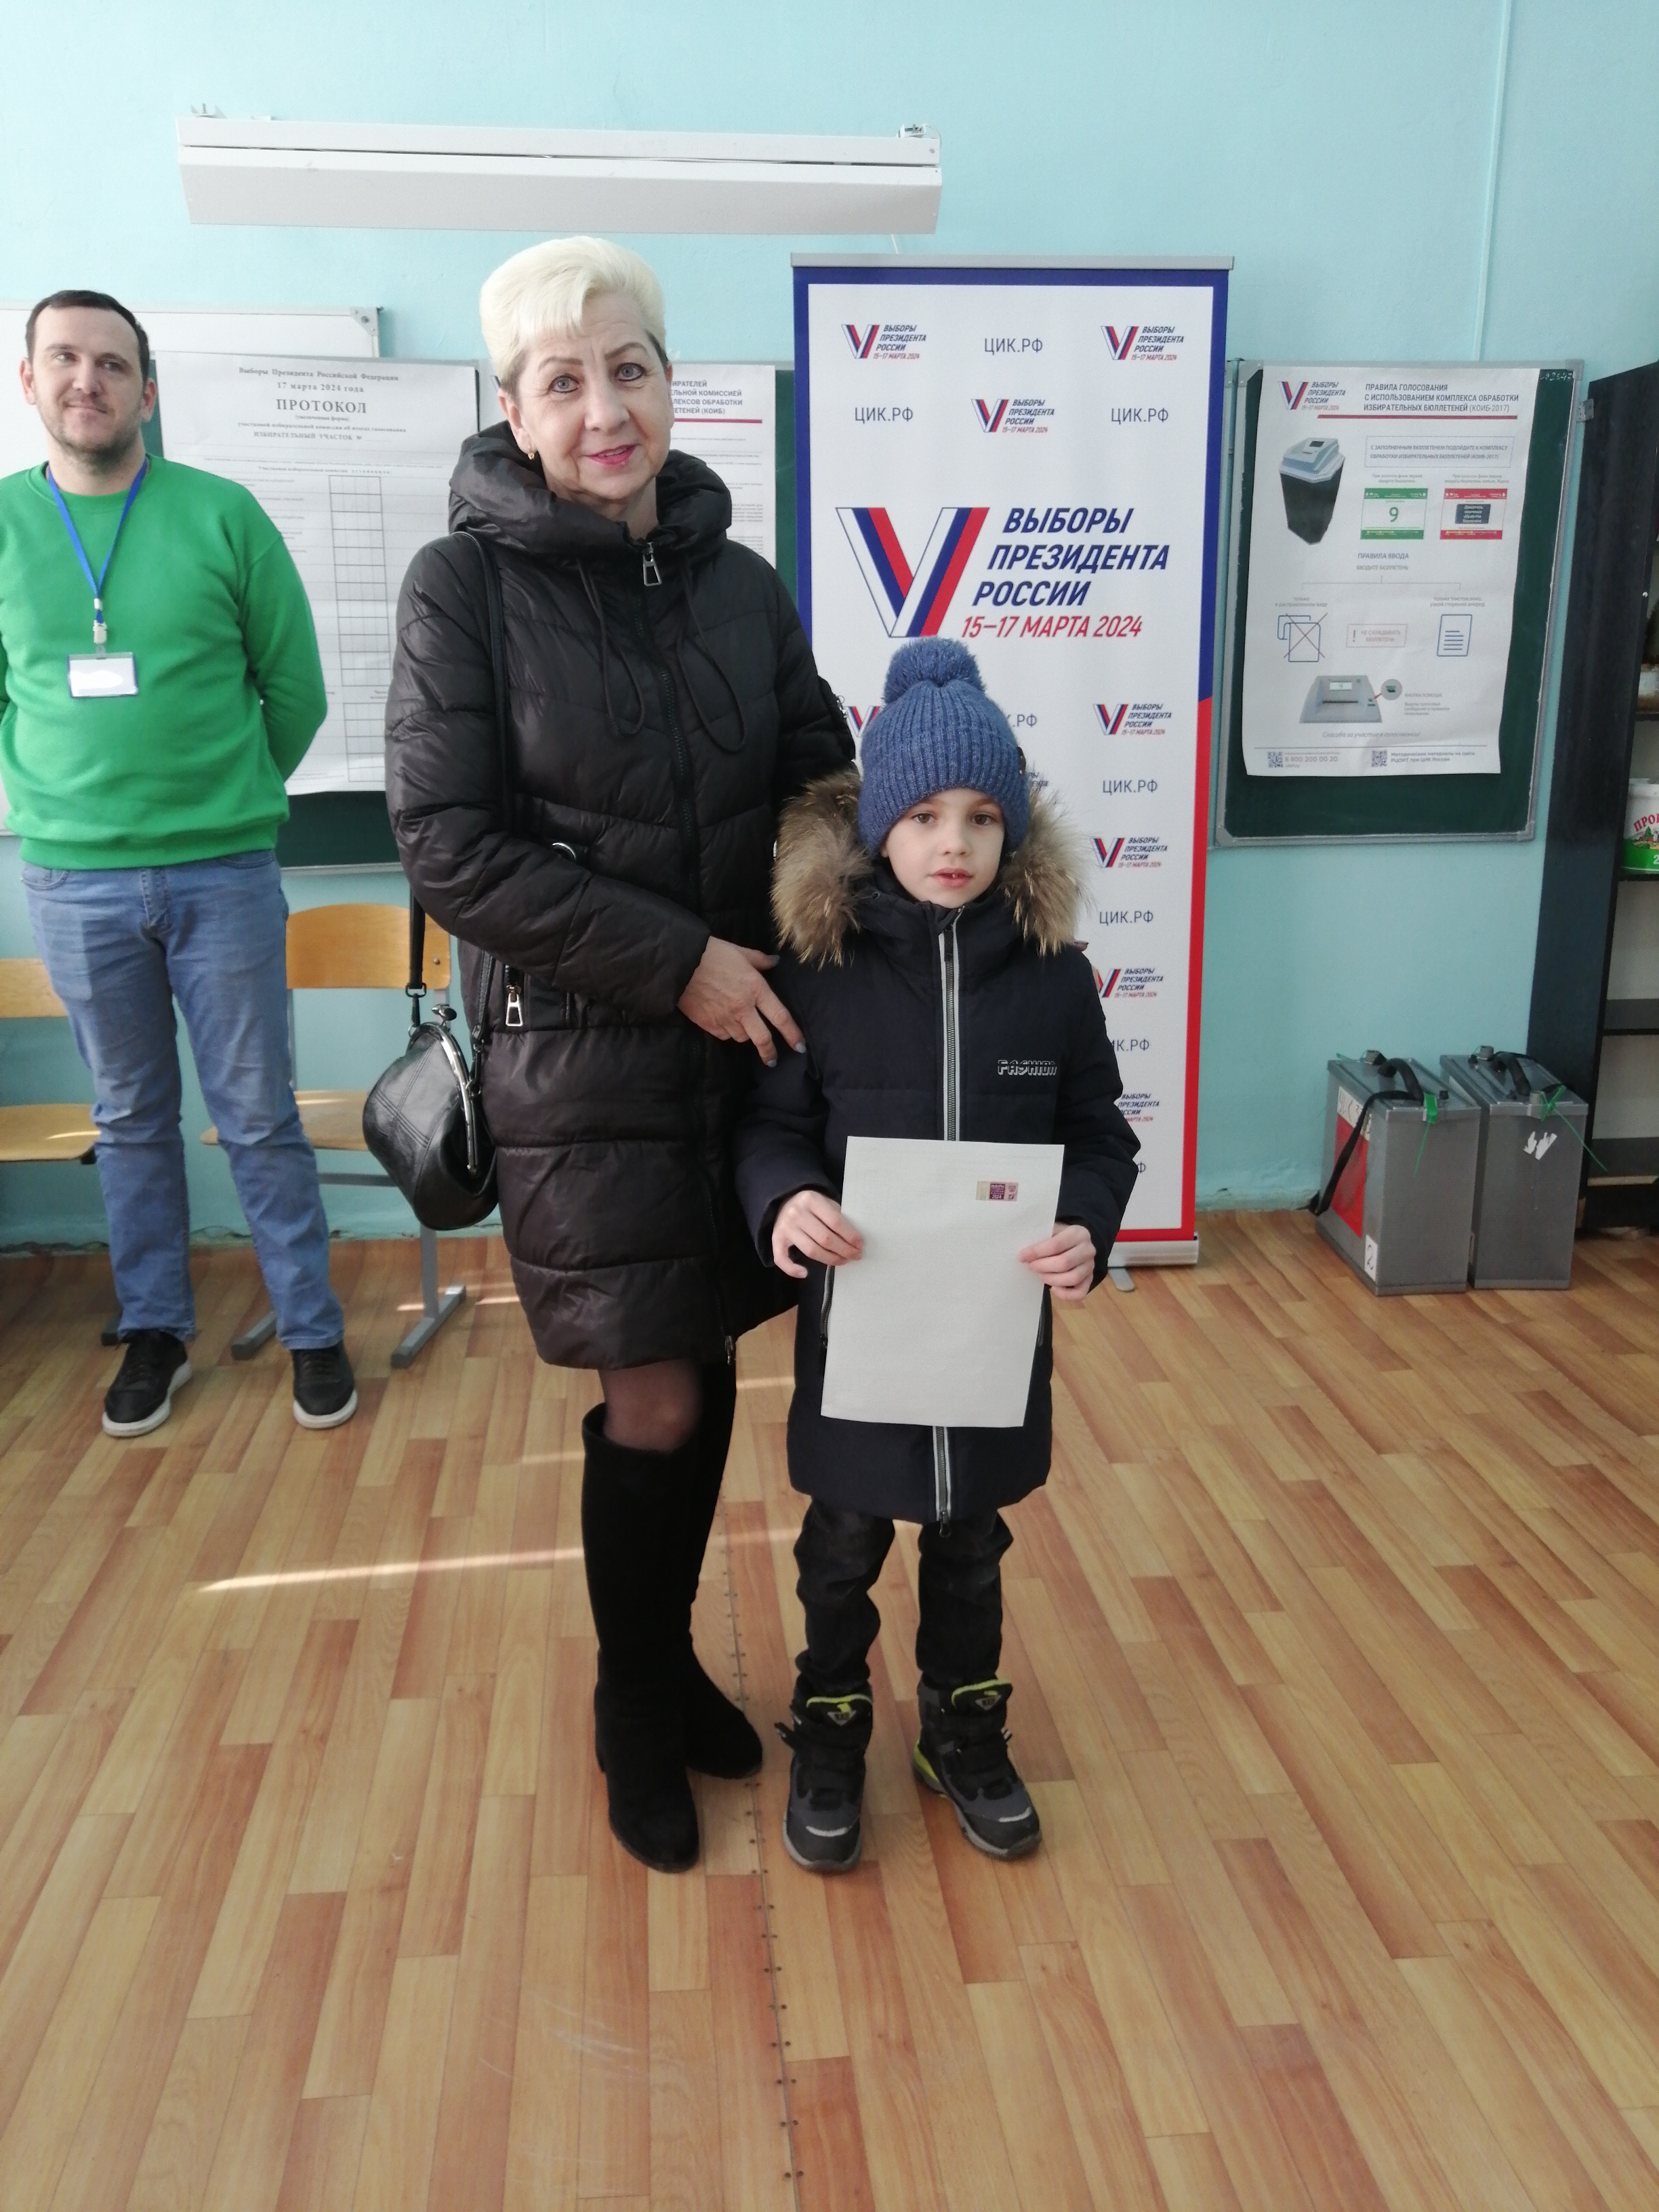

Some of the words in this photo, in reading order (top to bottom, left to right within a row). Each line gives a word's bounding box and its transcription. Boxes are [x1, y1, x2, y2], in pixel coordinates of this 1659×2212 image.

[880, 334, 926, 342] ПРЕЗИДЕНТА
[984, 337, 1043, 355] ЦИК.РФ
[291, 384, 317, 392] марта
[276, 398, 367, 414] ПРОТОКОЛ
[855, 407, 914, 424] ЦИК.РФ
[1111, 407, 1169, 425] ЦИК.РФ
[1002, 508, 1134, 533] ВЫБОРЫ
[1389, 506, 1399, 523] 9
[987, 544, 1170, 574] ПРЕЗИДЕНТА
[972, 581, 1092, 607] РОССИИ
[1019, 616, 1089, 638] МАРТА
[1092, 616, 1143, 638] 2024
[1103, 779, 1158, 796] ЦИК.РФ
[1099, 911, 1153, 926] ЦИК.РФ
[1112, 1039, 1149, 1051] К.РФ
